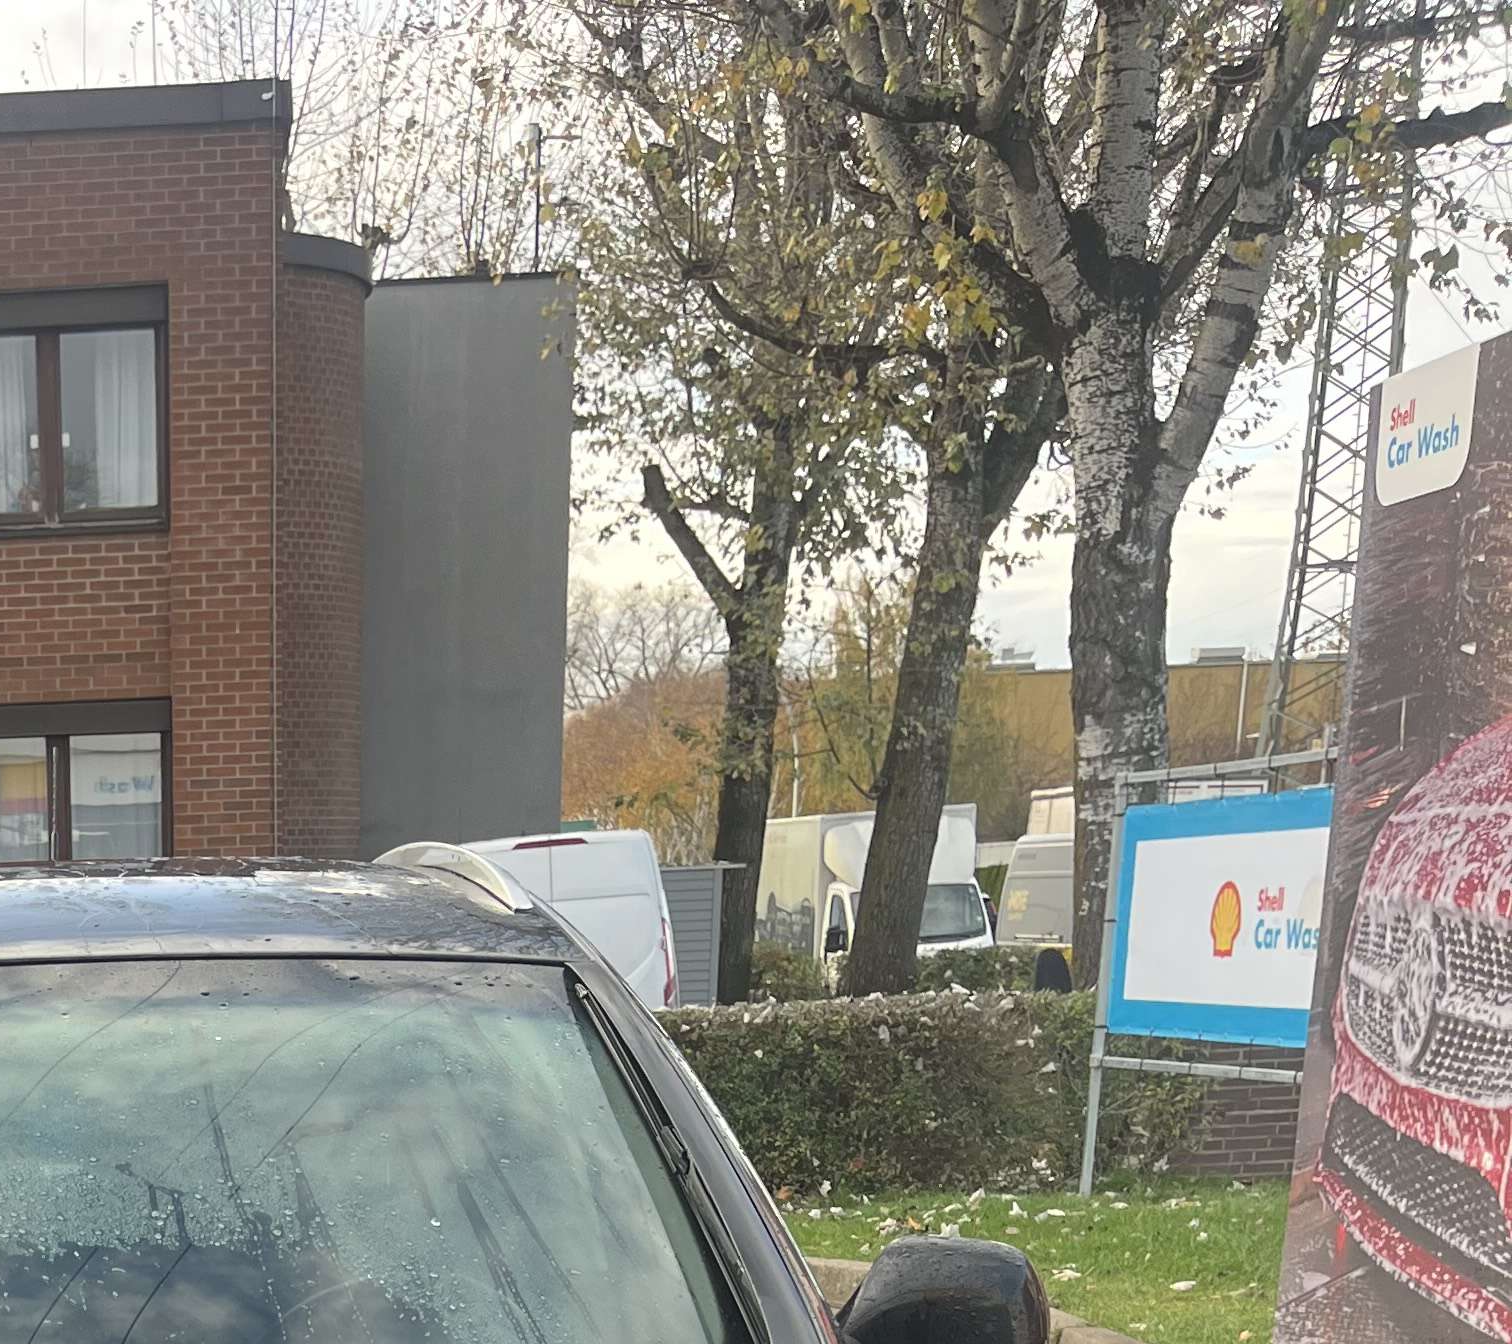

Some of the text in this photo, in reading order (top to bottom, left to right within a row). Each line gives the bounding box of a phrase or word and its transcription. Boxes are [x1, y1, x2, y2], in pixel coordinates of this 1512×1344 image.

[1390, 398, 1416, 432] Shell
[1387, 412, 1460, 469] Car Wash
[1257, 887, 1285, 912] Shell
[1254, 918, 1320, 950] Car Was
